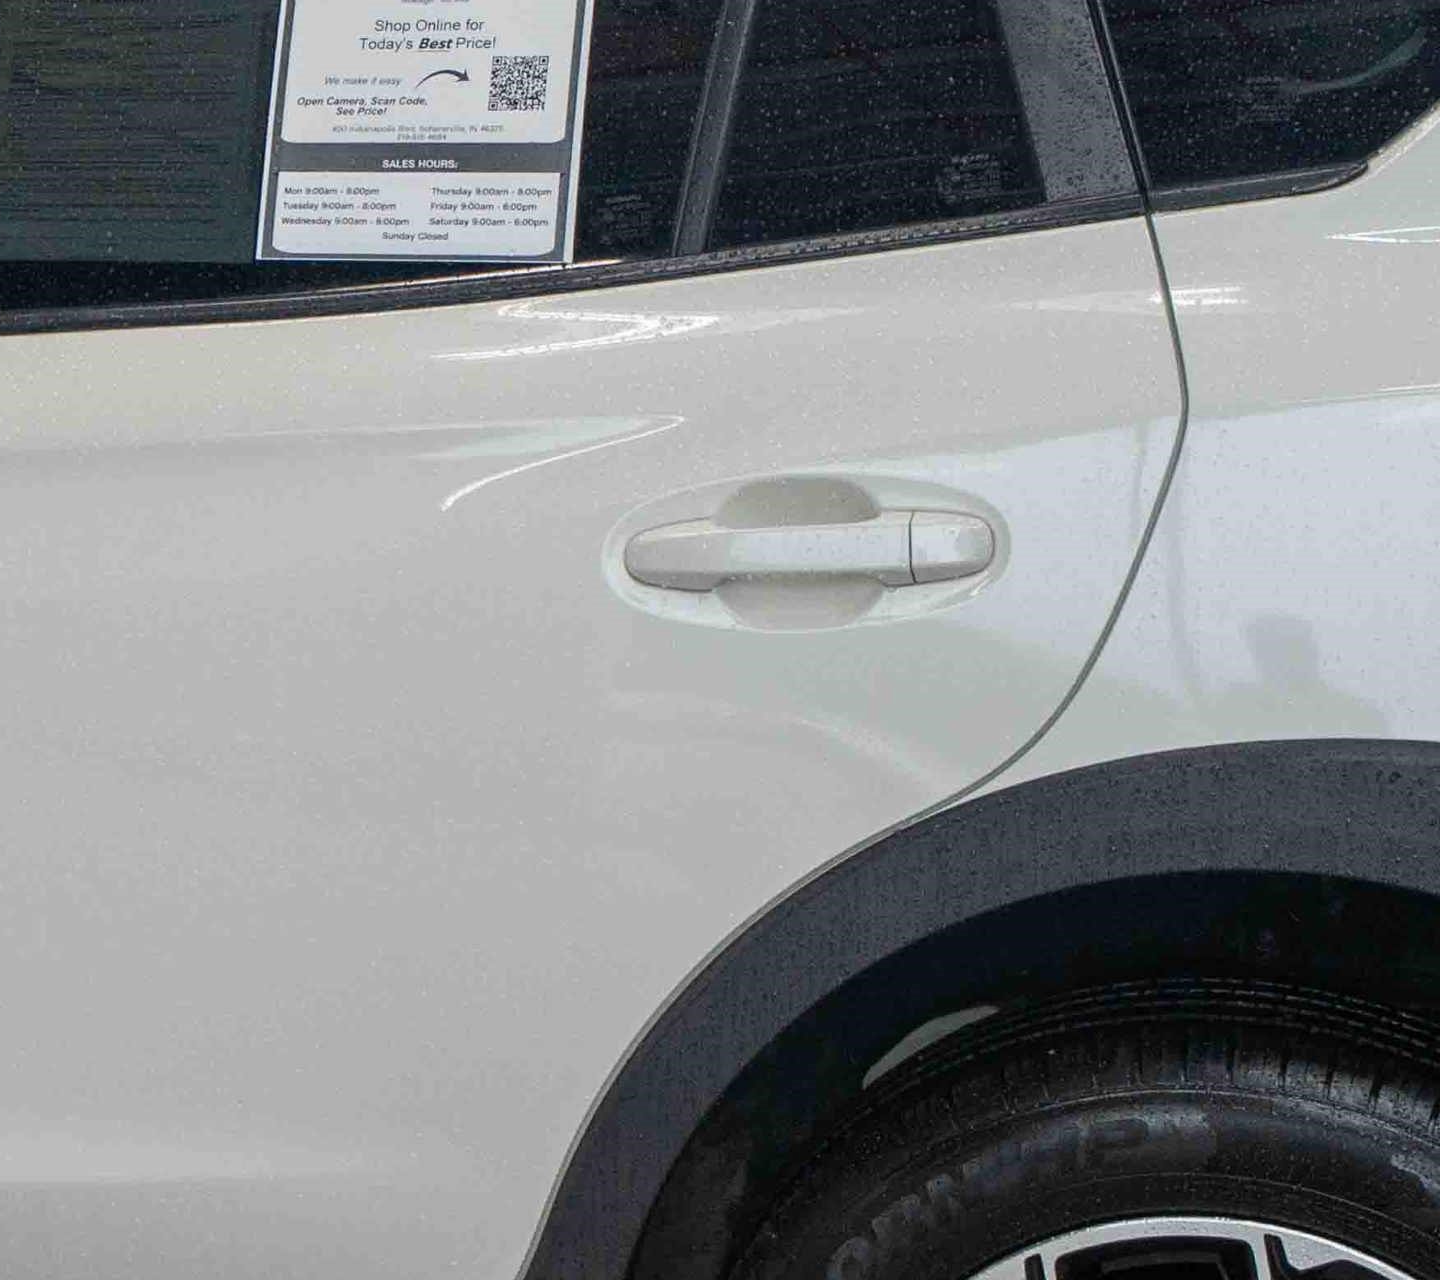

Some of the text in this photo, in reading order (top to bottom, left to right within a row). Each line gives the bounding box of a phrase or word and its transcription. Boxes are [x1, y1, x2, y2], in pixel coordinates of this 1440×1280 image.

[374, 18, 486, 34] Shop Online for
[359, 36, 497, 52] Today's Best Price!
[297, 96, 429, 109] Open Camera, Scan Code,
[335, 106, 389, 117] See Price!
[381, 159, 459, 169] SALES HOURS:
[284, 186, 303, 195] Mon
[431, 187, 472, 197] Thursday
[283, 201, 319, 211] Tuesday
[429, 202, 458, 212] Friday
[281, 216, 332, 227] Wednesday
[428, 217, 469, 227] Saturday
[381, 231, 449, 242] Sunday Closed
